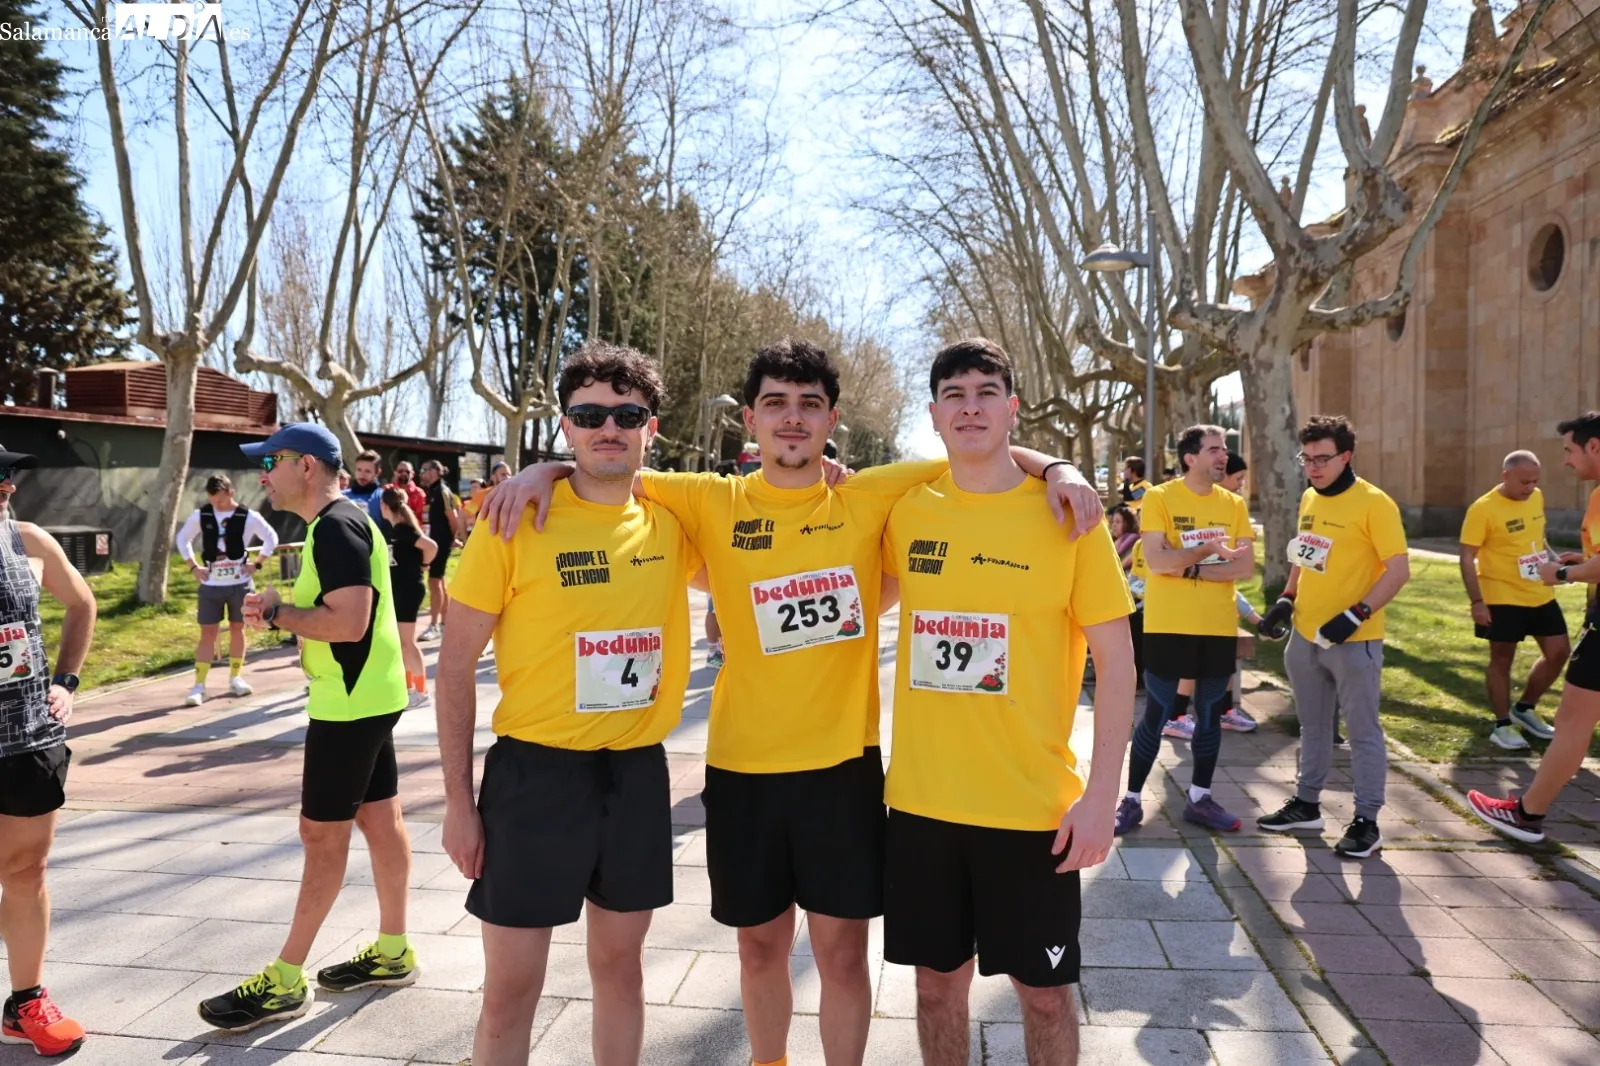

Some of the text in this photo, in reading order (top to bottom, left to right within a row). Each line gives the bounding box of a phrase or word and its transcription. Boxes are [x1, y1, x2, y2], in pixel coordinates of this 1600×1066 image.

[765, 519, 774, 532] EL
[731, 533, 773, 551] SILENCIO!
[938, 541, 948, 557] EL
[1297, 544, 1316, 560] 32
[556, 550, 609, 571] ¡ROMPE EL
[908, 557, 944, 575] SILENCIO!
[560, 567, 611, 587] SILENCIO!
[753, 572, 855, 605] bedunia
[777, 595, 841, 633] 253
[914, 615, 1006, 639] bedunia
[578, 632, 661, 657] bedunia
[935, 640, 973, 672] 39
[621, 658, 638, 688] 4
